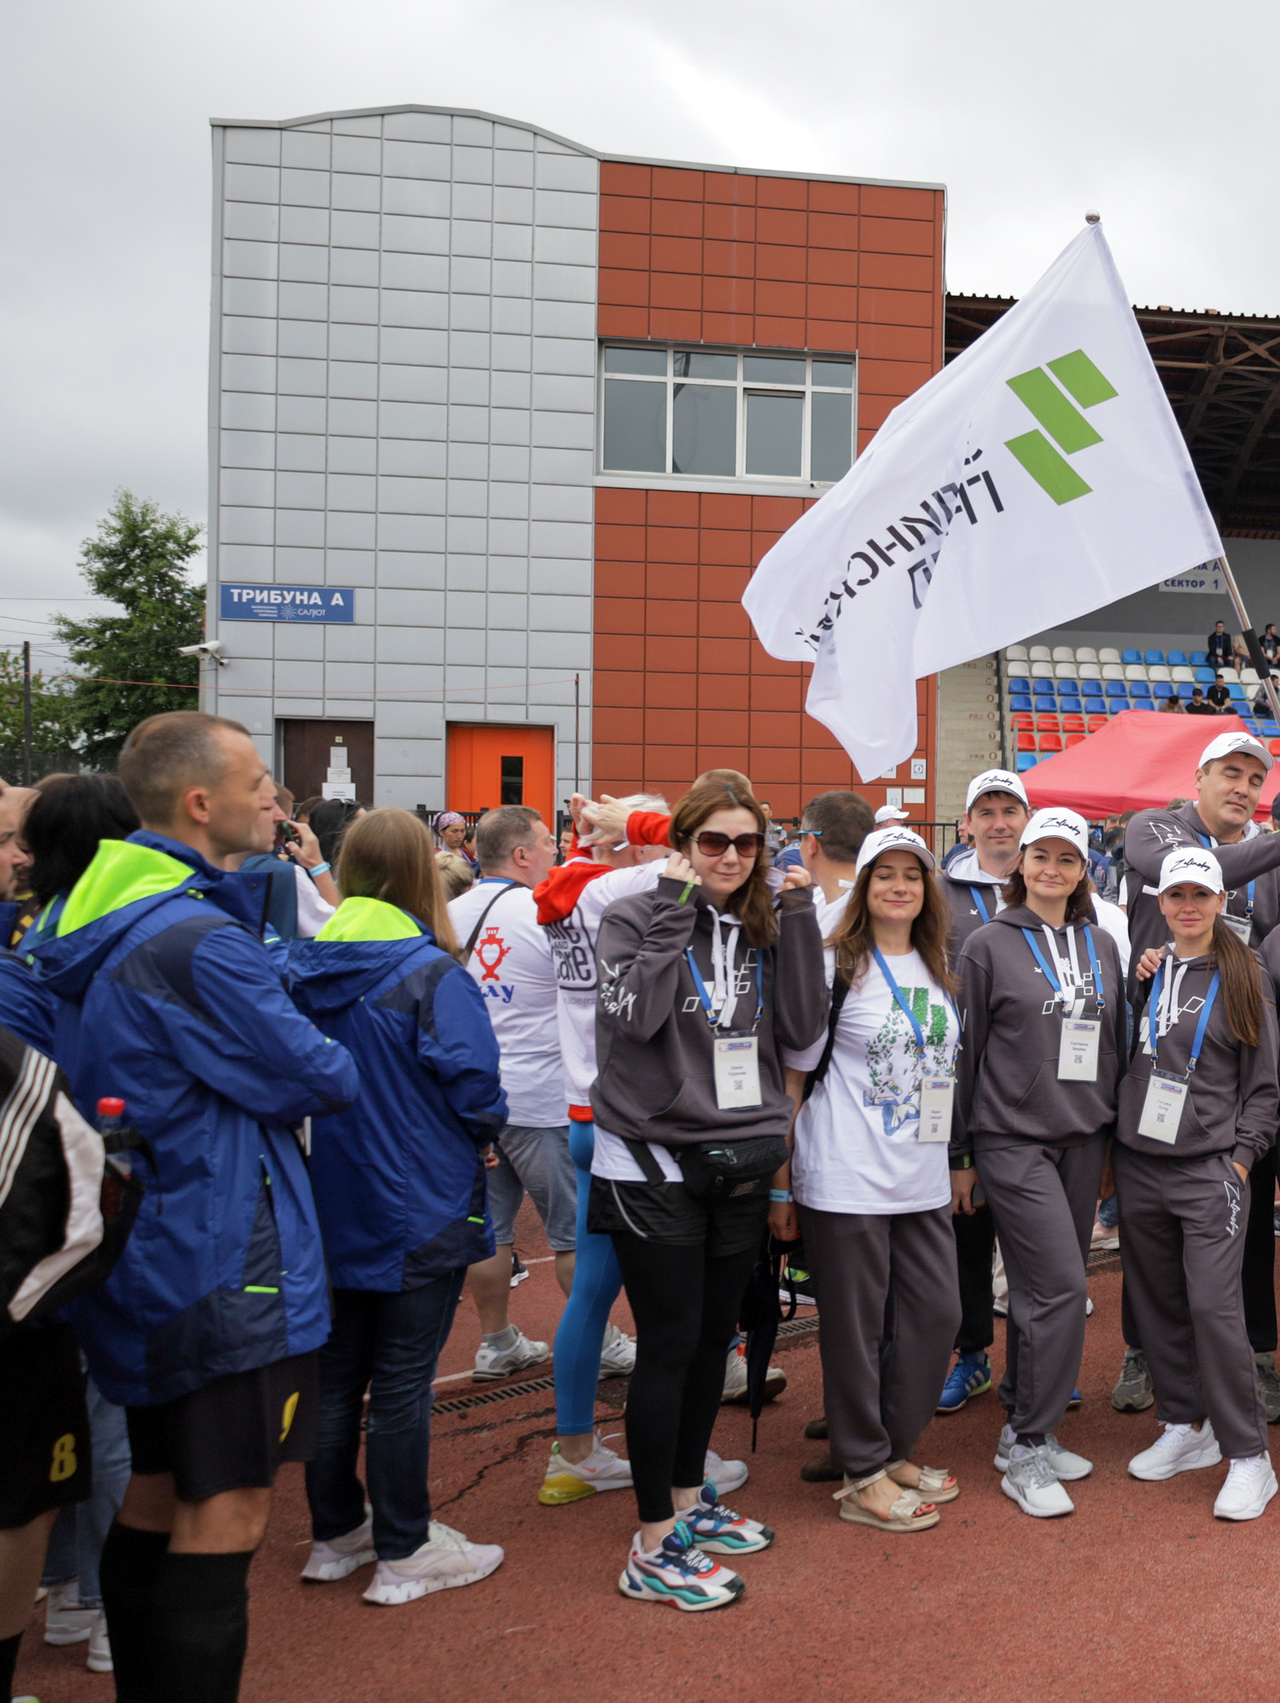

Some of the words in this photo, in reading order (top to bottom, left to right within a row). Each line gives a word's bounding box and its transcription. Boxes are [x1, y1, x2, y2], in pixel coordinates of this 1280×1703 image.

[1164, 579, 1205, 588] СЕКТОР
[1213, 580, 1218, 589] 1
[230, 589, 322, 605] ТРИБУНА
[331, 593, 344, 606] А
[298, 608, 326, 618] САЛЮТ
[49, 1433, 78, 1482] 8
